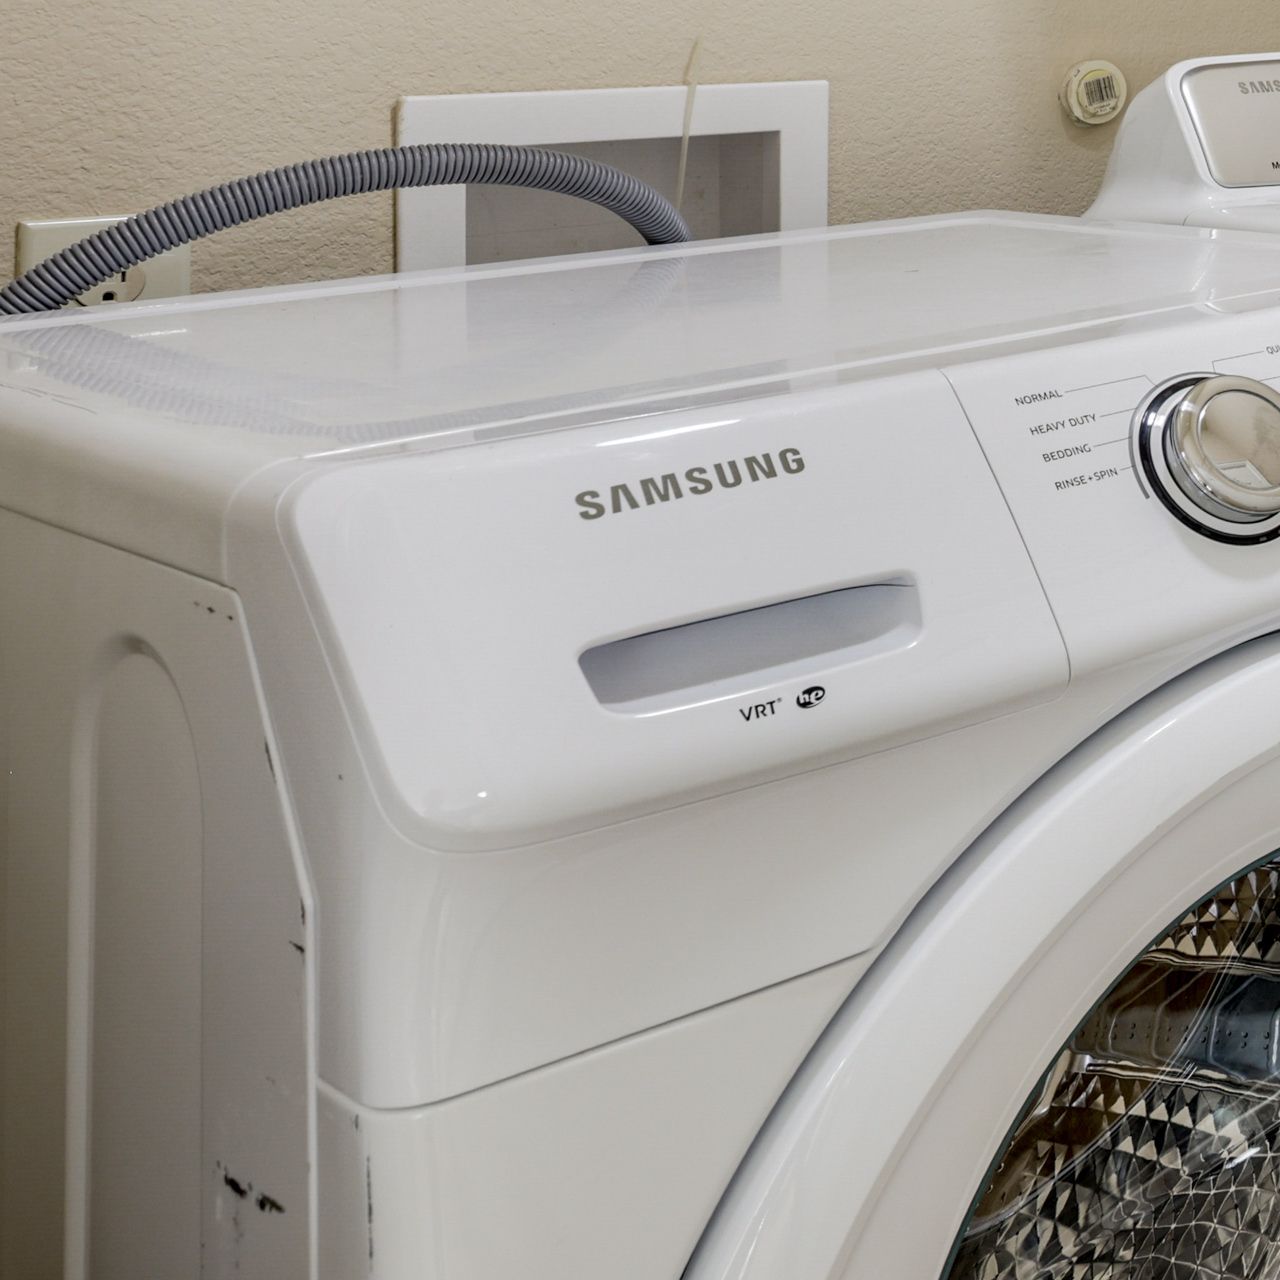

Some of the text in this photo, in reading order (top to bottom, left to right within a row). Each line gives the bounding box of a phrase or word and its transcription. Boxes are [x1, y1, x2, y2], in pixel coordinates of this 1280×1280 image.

[1014, 389, 1063, 406] NORMAL
[1029, 413, 1097, 436] HEAVY DUTY
[1042, 443, 1092, 463] BEDDING
[574, 447, 806, 520] SAMSUNG
[1054, 467, 1119, 491] RINSE+SPIN
